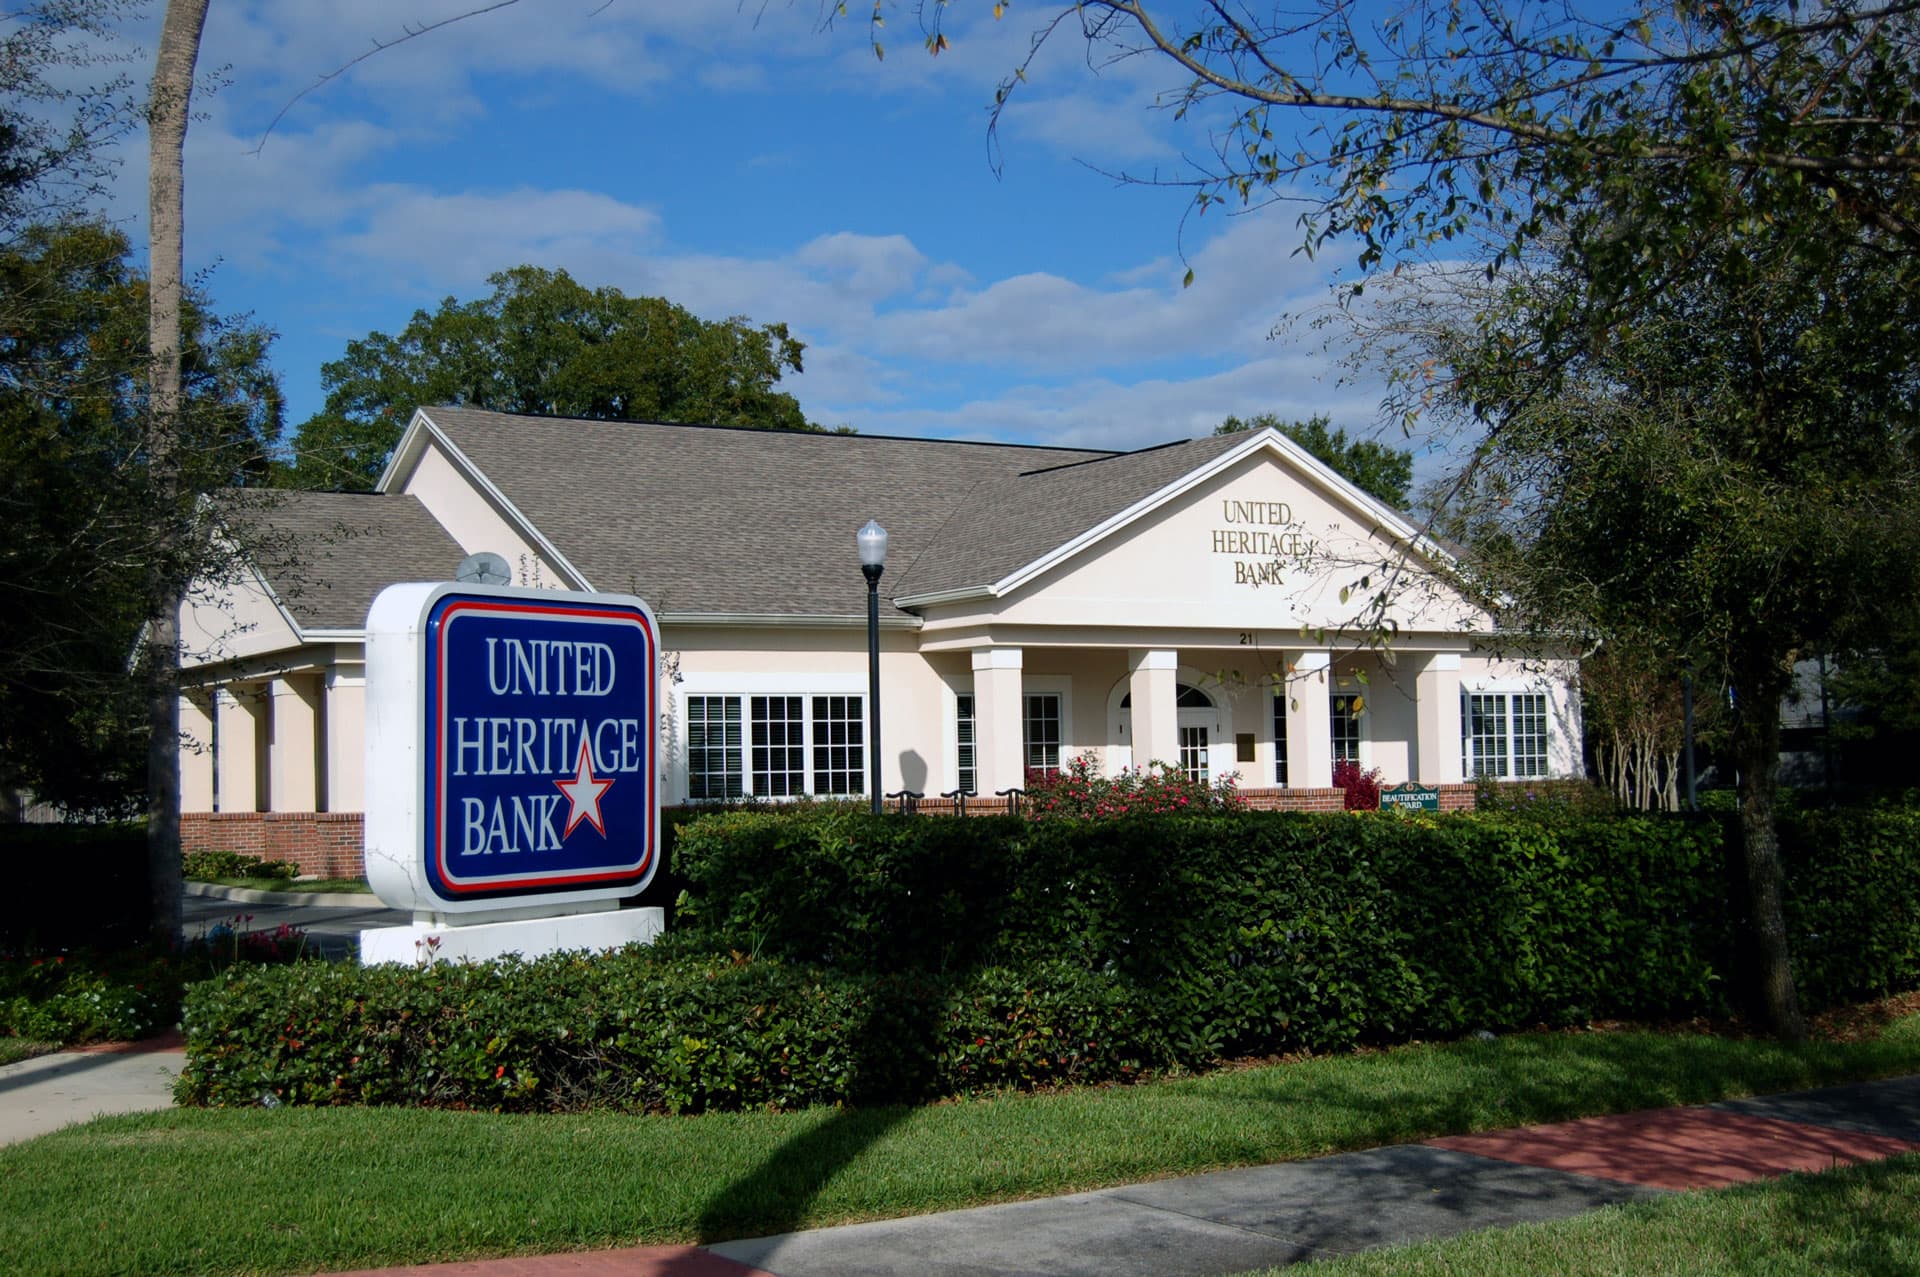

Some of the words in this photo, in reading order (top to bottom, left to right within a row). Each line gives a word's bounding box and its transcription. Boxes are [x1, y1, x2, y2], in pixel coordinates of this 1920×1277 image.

[1223, 500, 1291, 525] UNITED
[1212, 530, 1304, 556] HERITAGE
[1235, 561, 1284, 585] BANK
[1239, 632, 1253, 645] 21
[486, 638, 616, 696] UNITED
[453, 718, 639, 775] HERITAGE
[1382, 793, 1437, 802] BEAUTIFICATION
[1398, 801, 1423, 809] WARD
[461, 796, 563, 856] BANK
